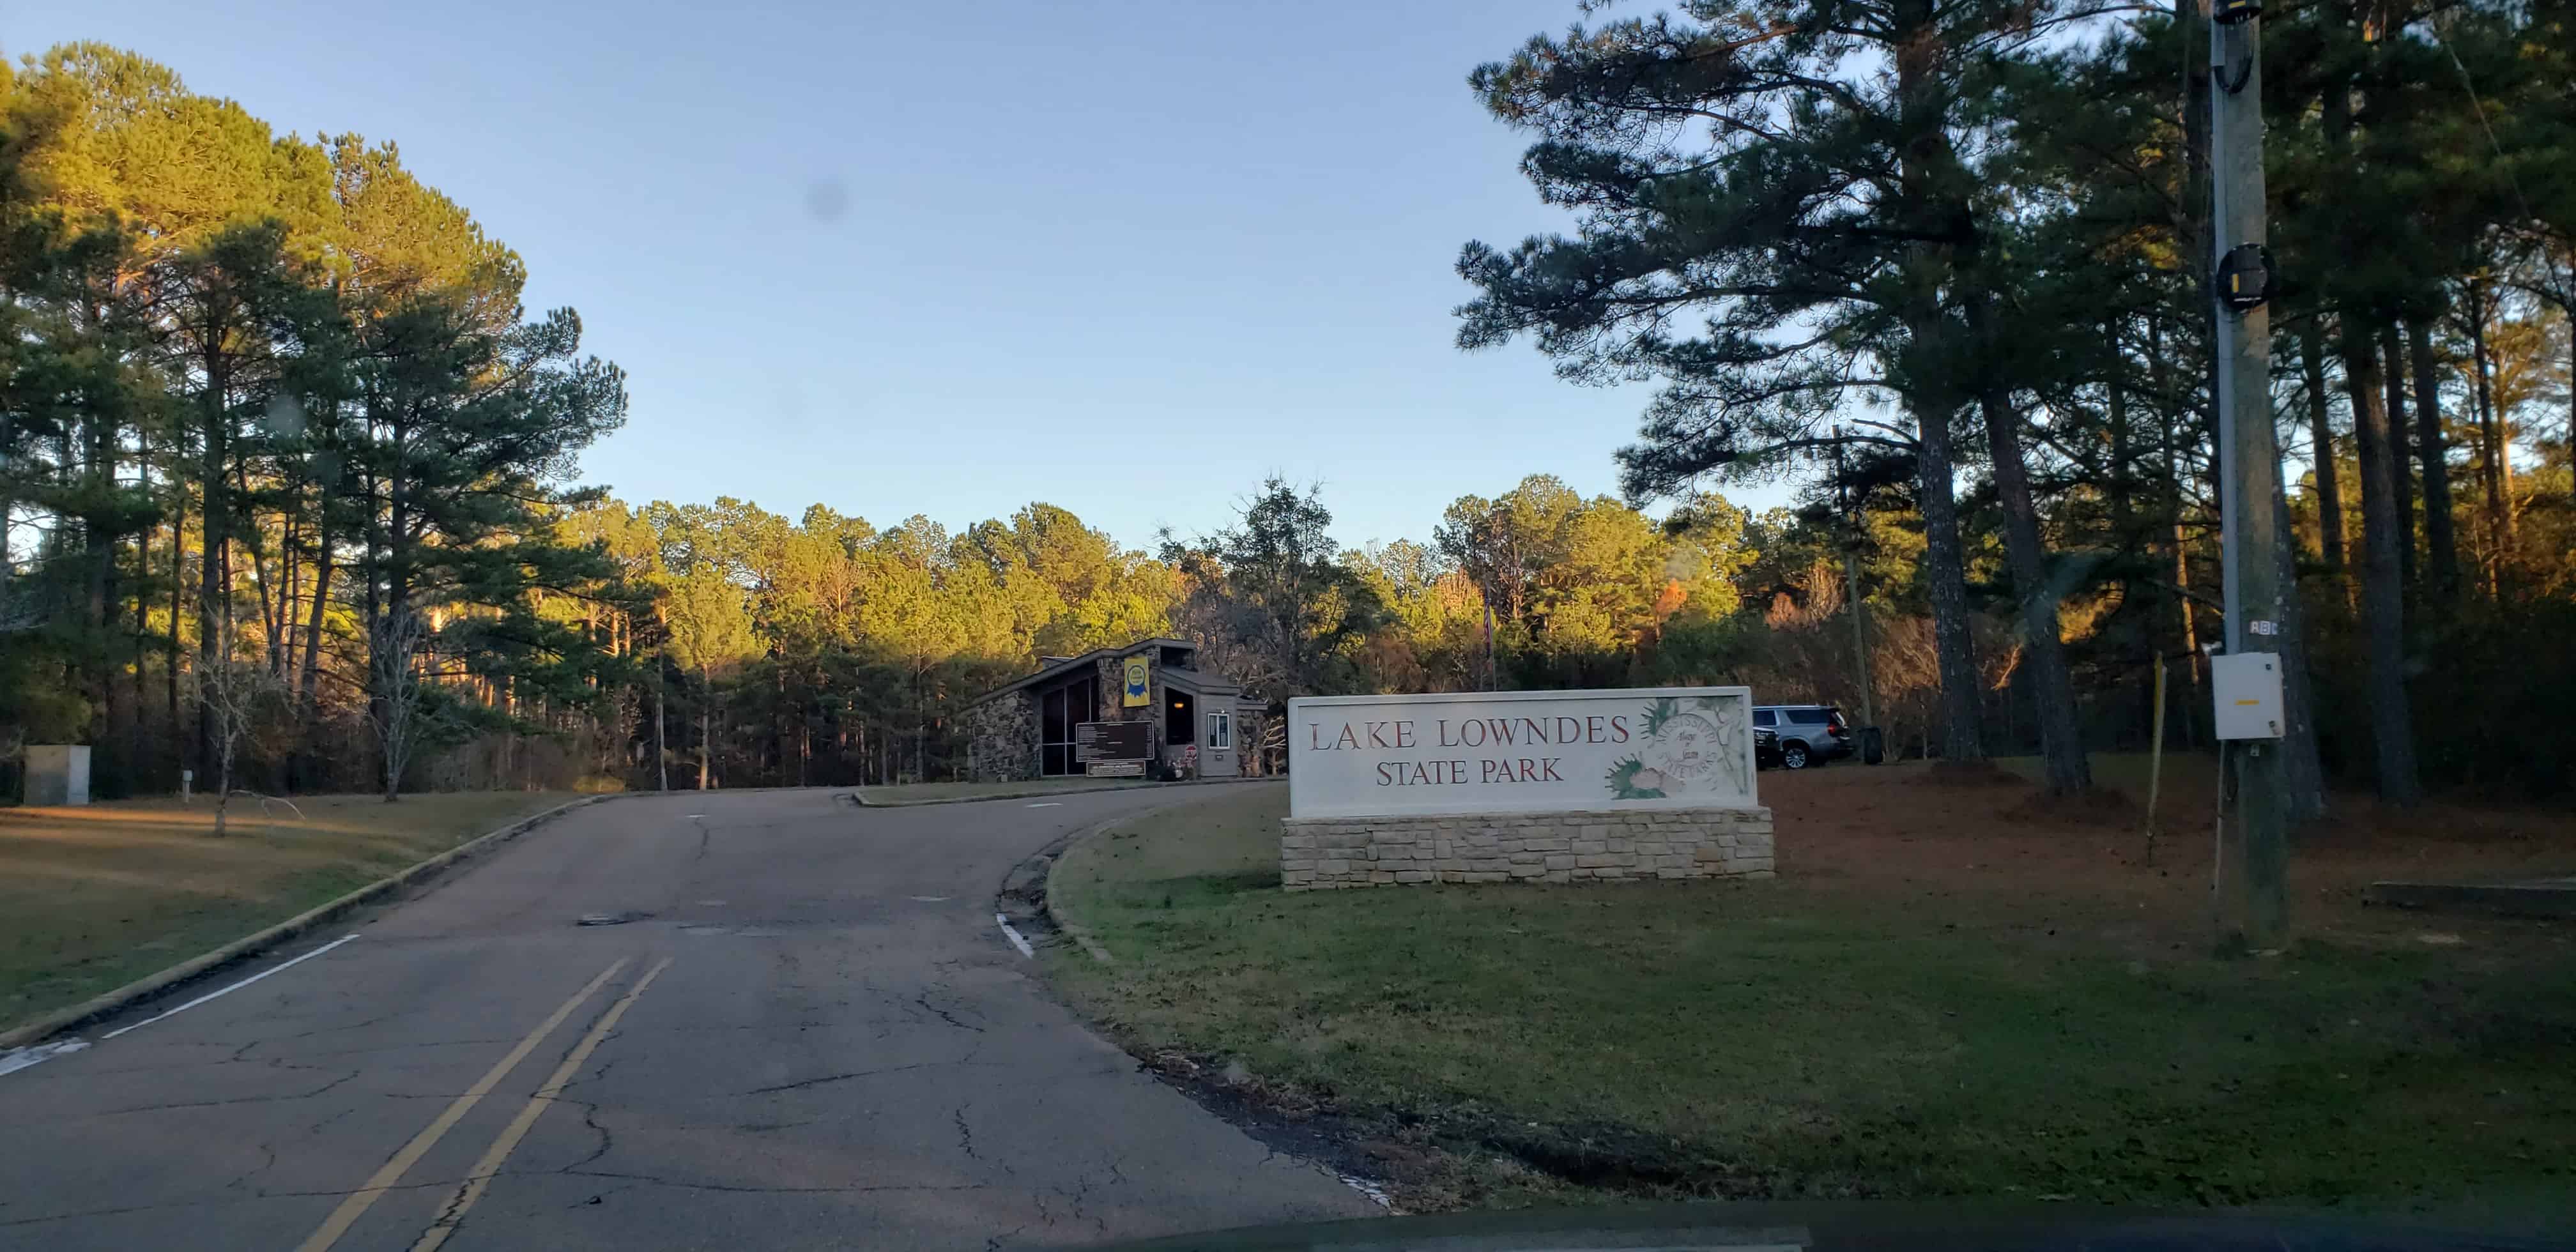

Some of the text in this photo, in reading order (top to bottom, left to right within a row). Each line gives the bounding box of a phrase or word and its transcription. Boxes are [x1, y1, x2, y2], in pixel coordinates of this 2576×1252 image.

[1308, 715, 1629, 750] LAKE LOWNDES
[1376, 758, 1564, 786] STATE PARK
